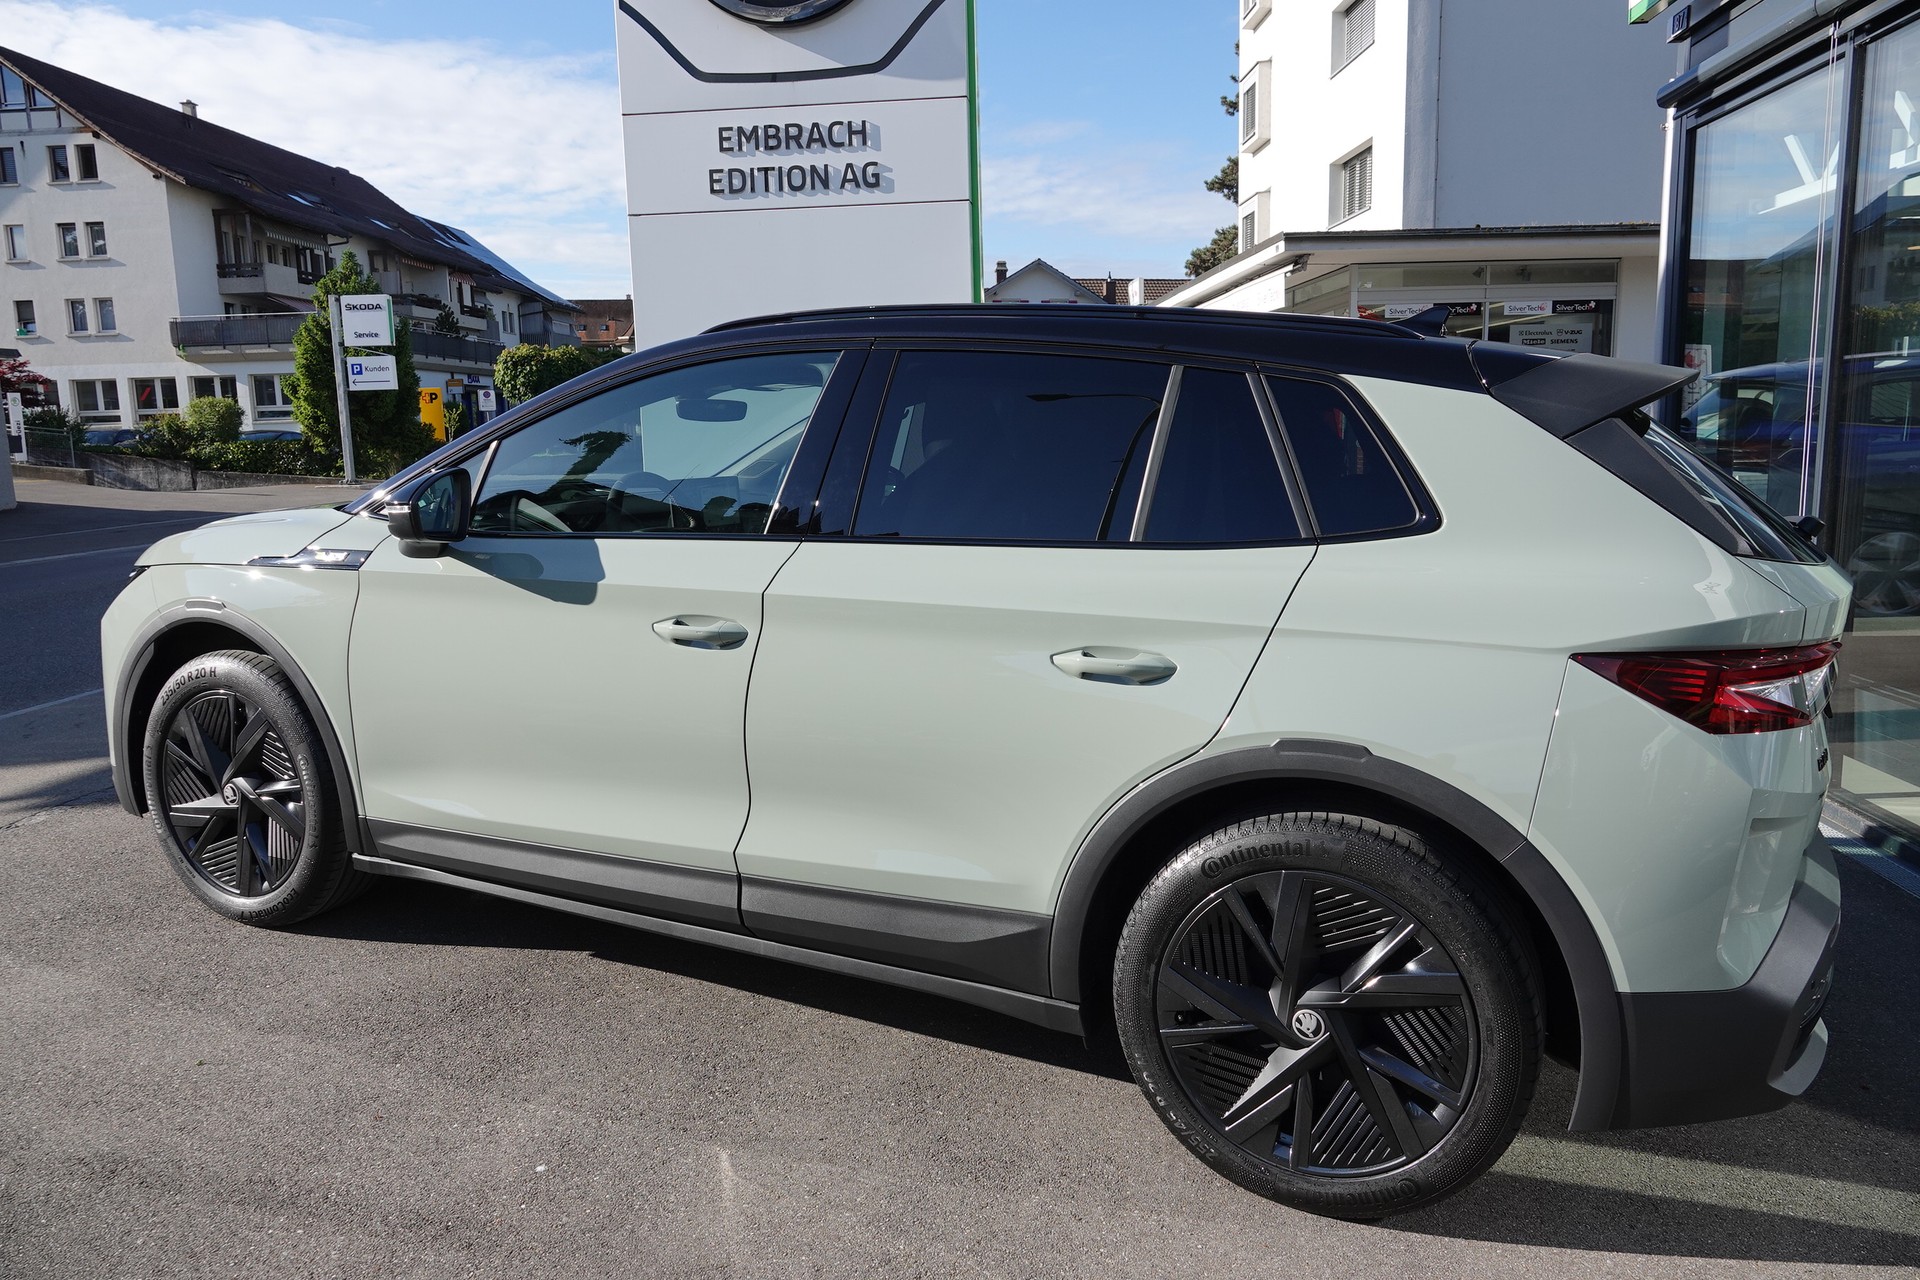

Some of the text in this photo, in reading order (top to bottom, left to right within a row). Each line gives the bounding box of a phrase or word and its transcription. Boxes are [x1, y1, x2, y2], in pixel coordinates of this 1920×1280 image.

[718, 119, 868, 153] EMBRACH
[708, 161, 881, 195] EDITION AG
[344, 303, 383, 311] ŠKODA
[1508, 304, 1543, 312] SilverTech
[1555, 303, 1590, 311] SilverTech
[364, 365, 390, 373] Kunden
[161, 675, 186, 706] 235/50
[209, 666, 217, 678] H
[1200, 839, 1312, 879] Continental
[249, 887, 297, 921] EcoContact
